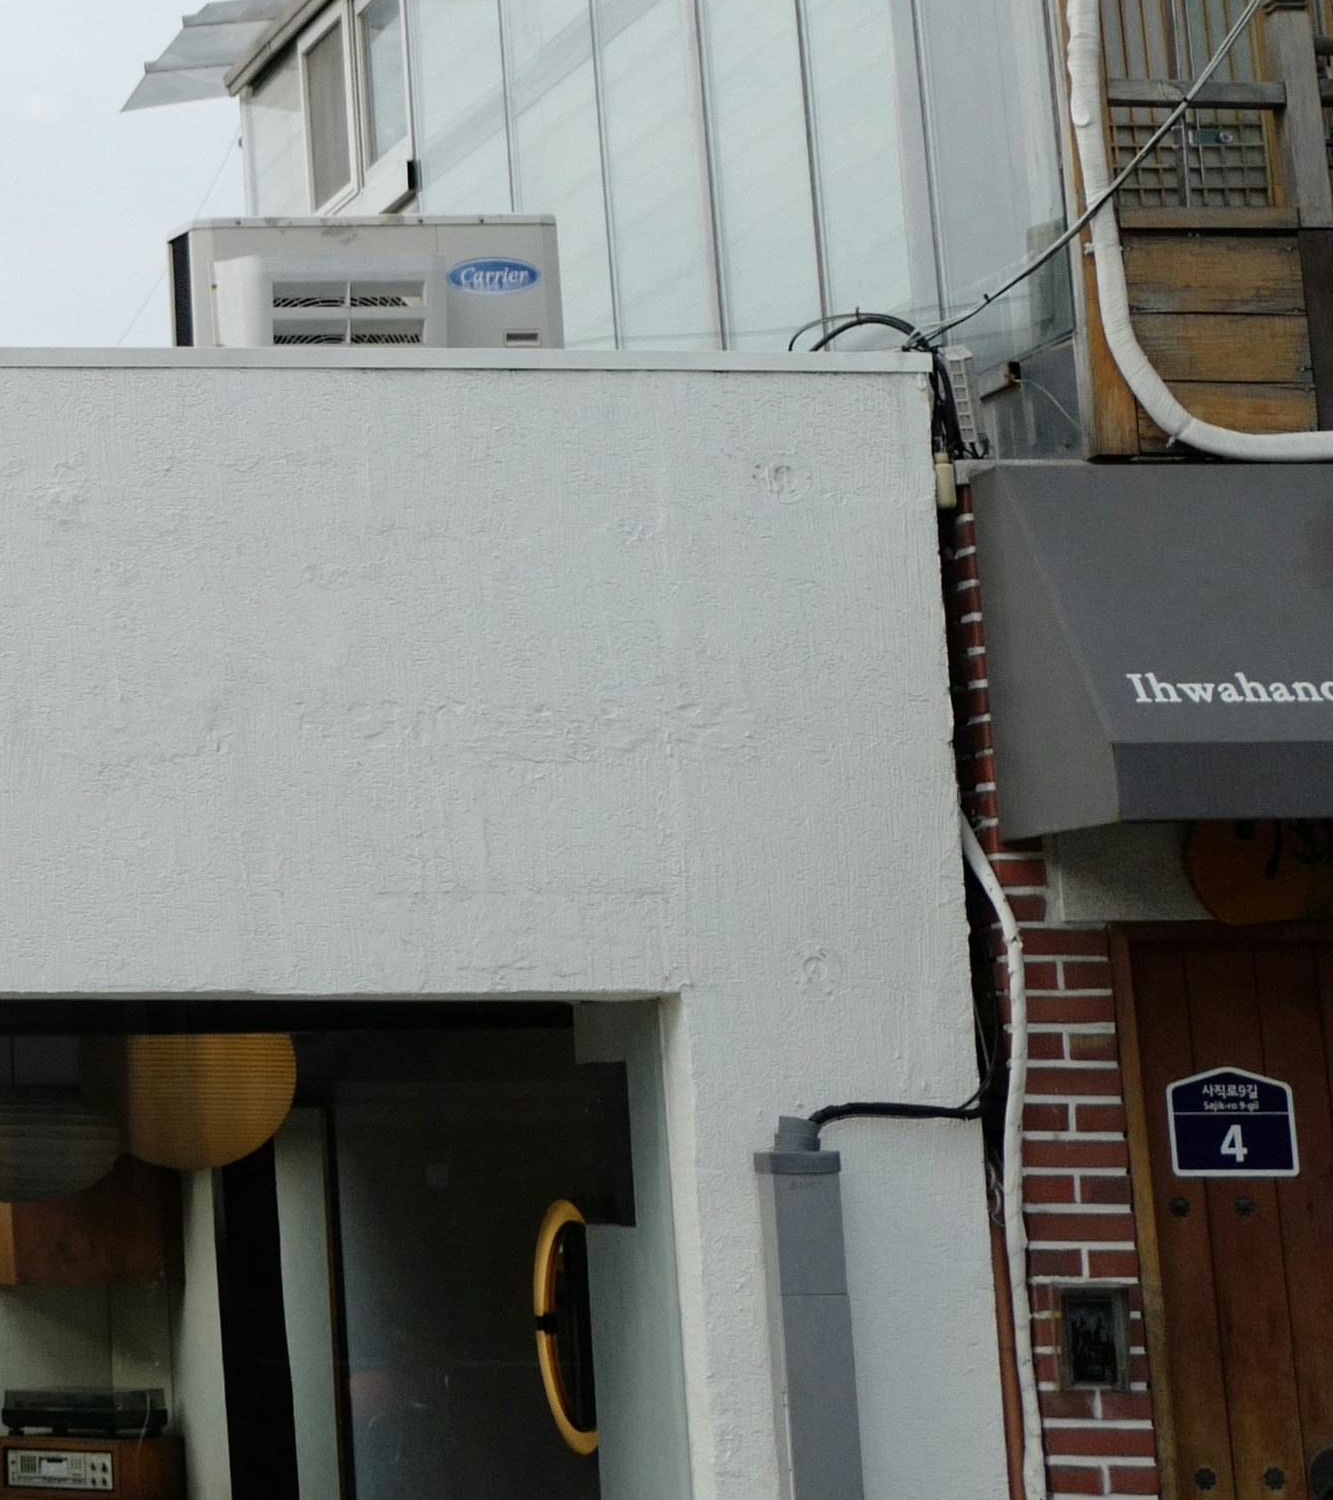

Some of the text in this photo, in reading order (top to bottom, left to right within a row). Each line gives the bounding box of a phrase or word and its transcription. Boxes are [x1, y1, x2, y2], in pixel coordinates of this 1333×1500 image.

[460, 266, 529, 284] Carrier
[1202, 1083, 1259, 1100] 사직로9길
[1203, 1100, 1260, 1112] Sajik-ro 9-gil
[1220, 1124, 1248, 1163] 4
